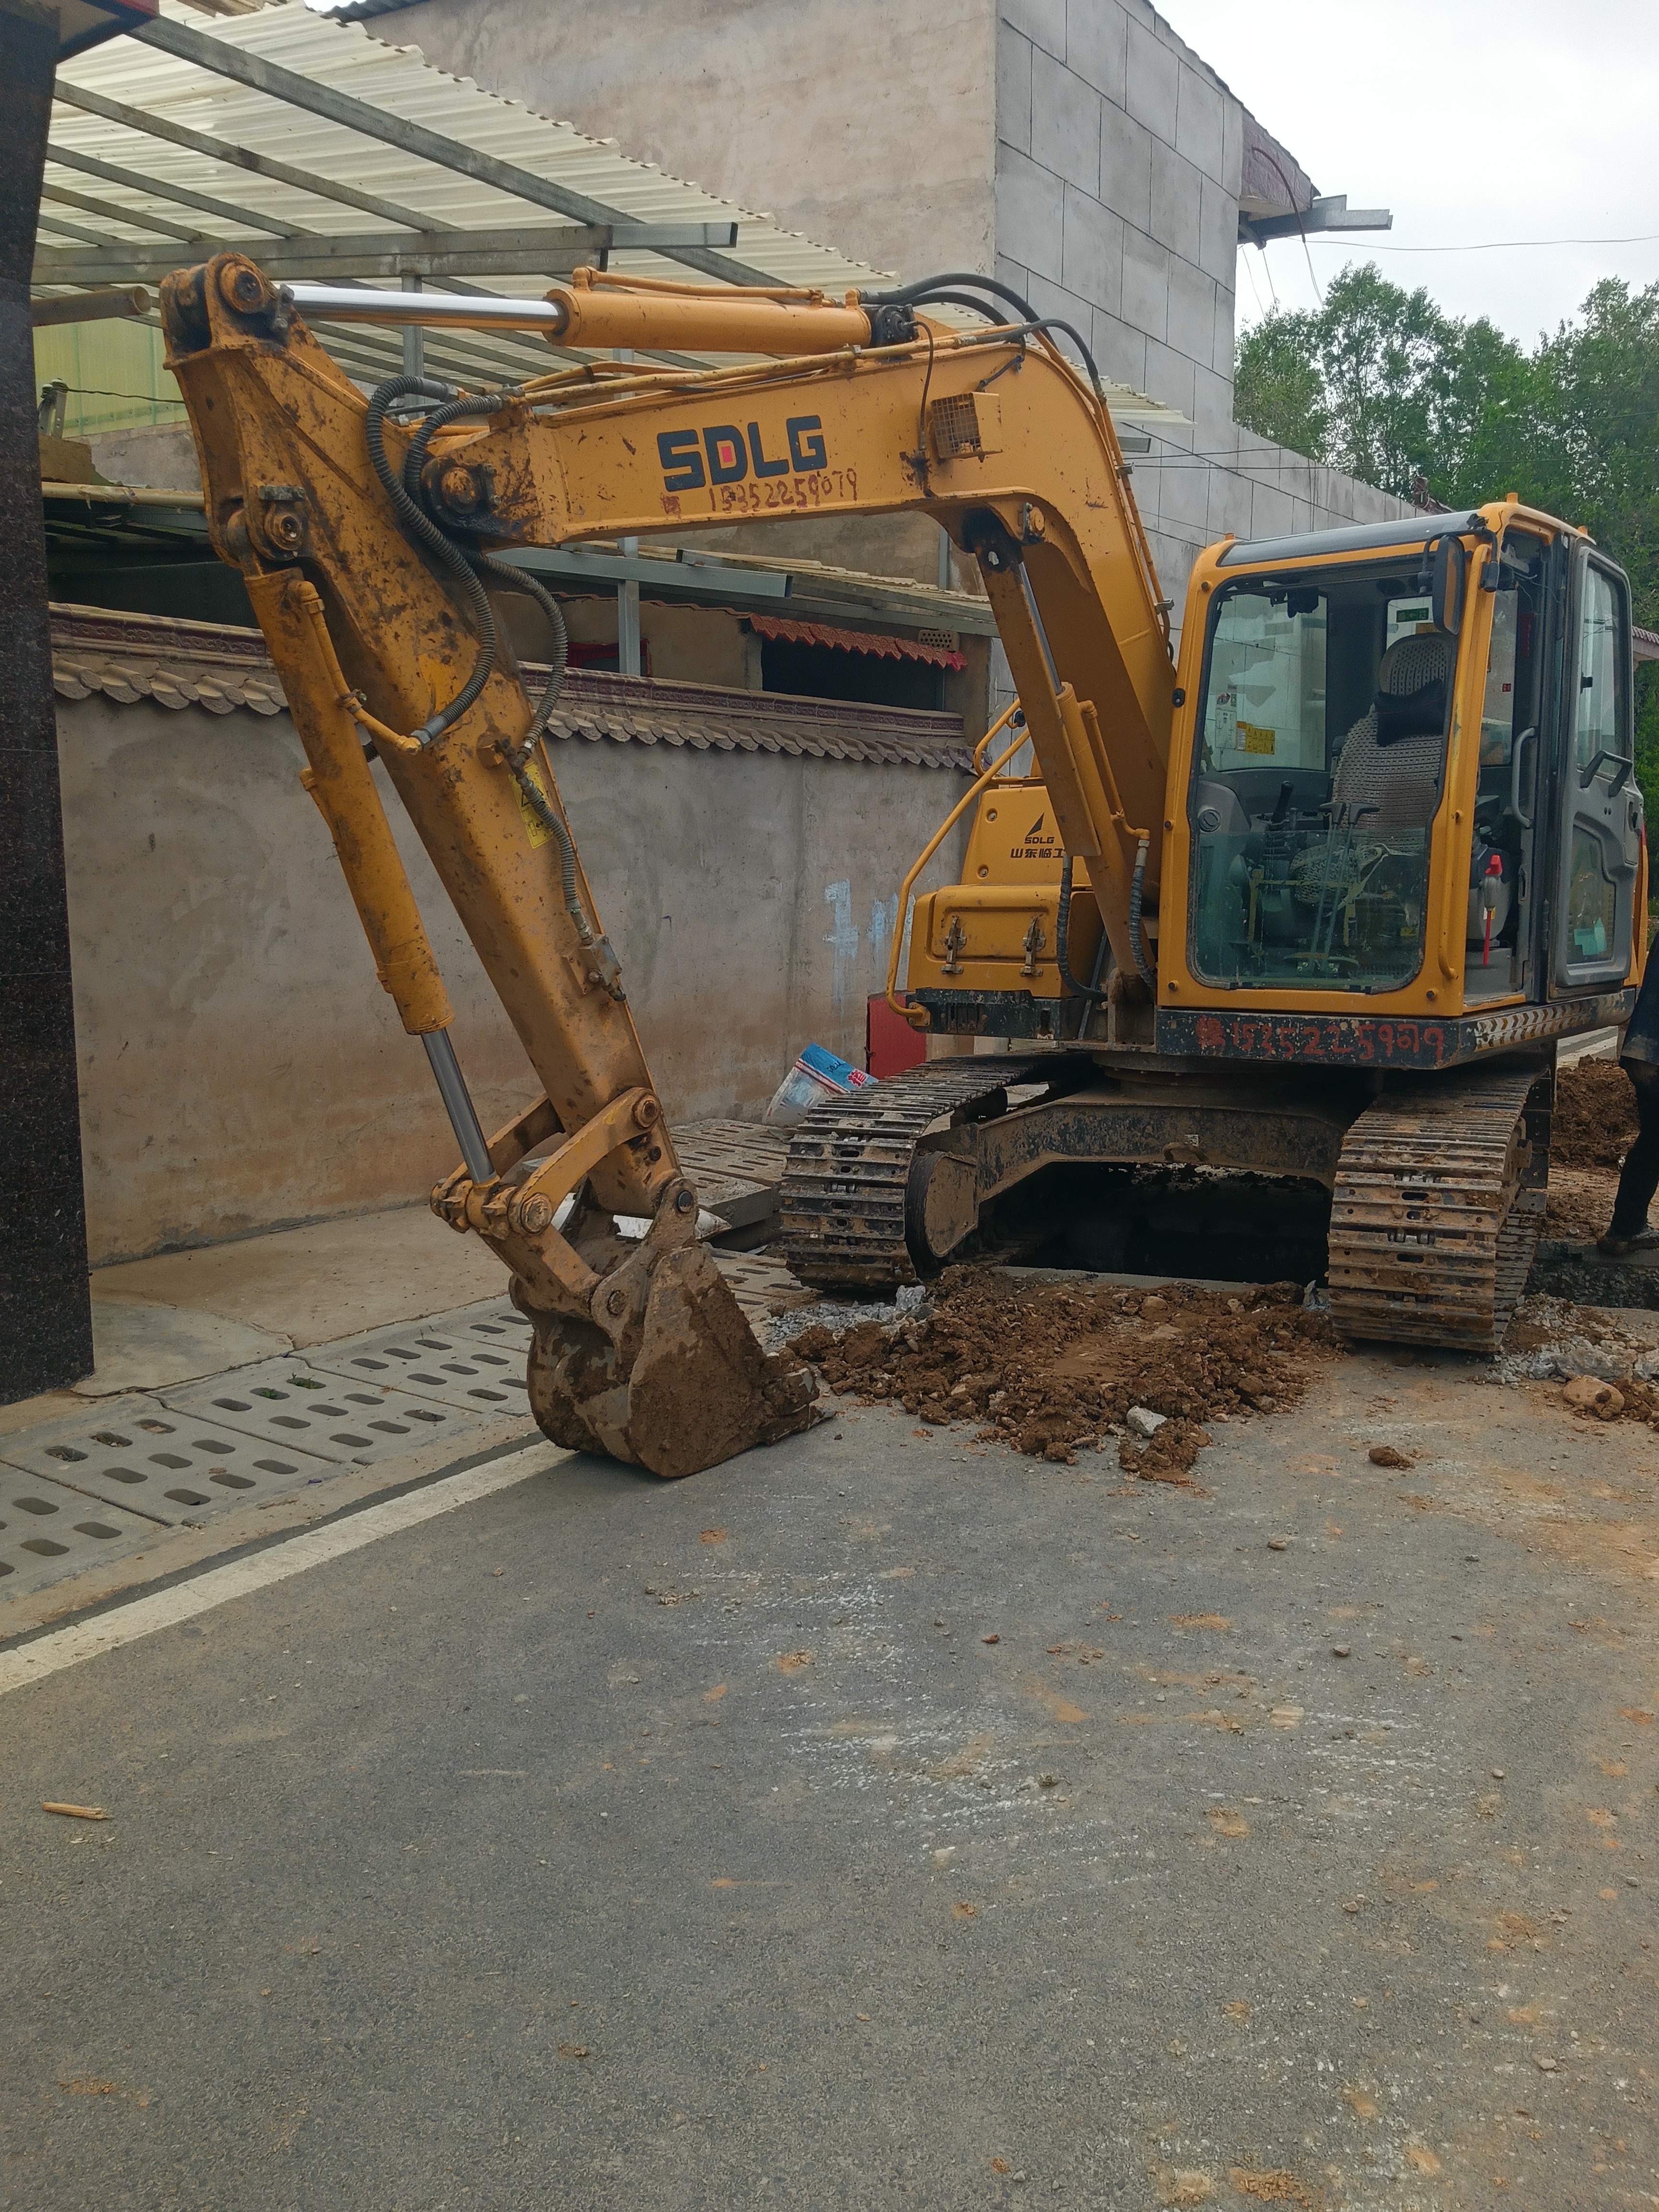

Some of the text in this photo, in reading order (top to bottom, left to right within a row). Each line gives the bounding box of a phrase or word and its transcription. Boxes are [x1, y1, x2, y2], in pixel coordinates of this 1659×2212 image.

[657, 415, 828, 492] SDLG
[1010, 848, 1065, 858] 山东临工
